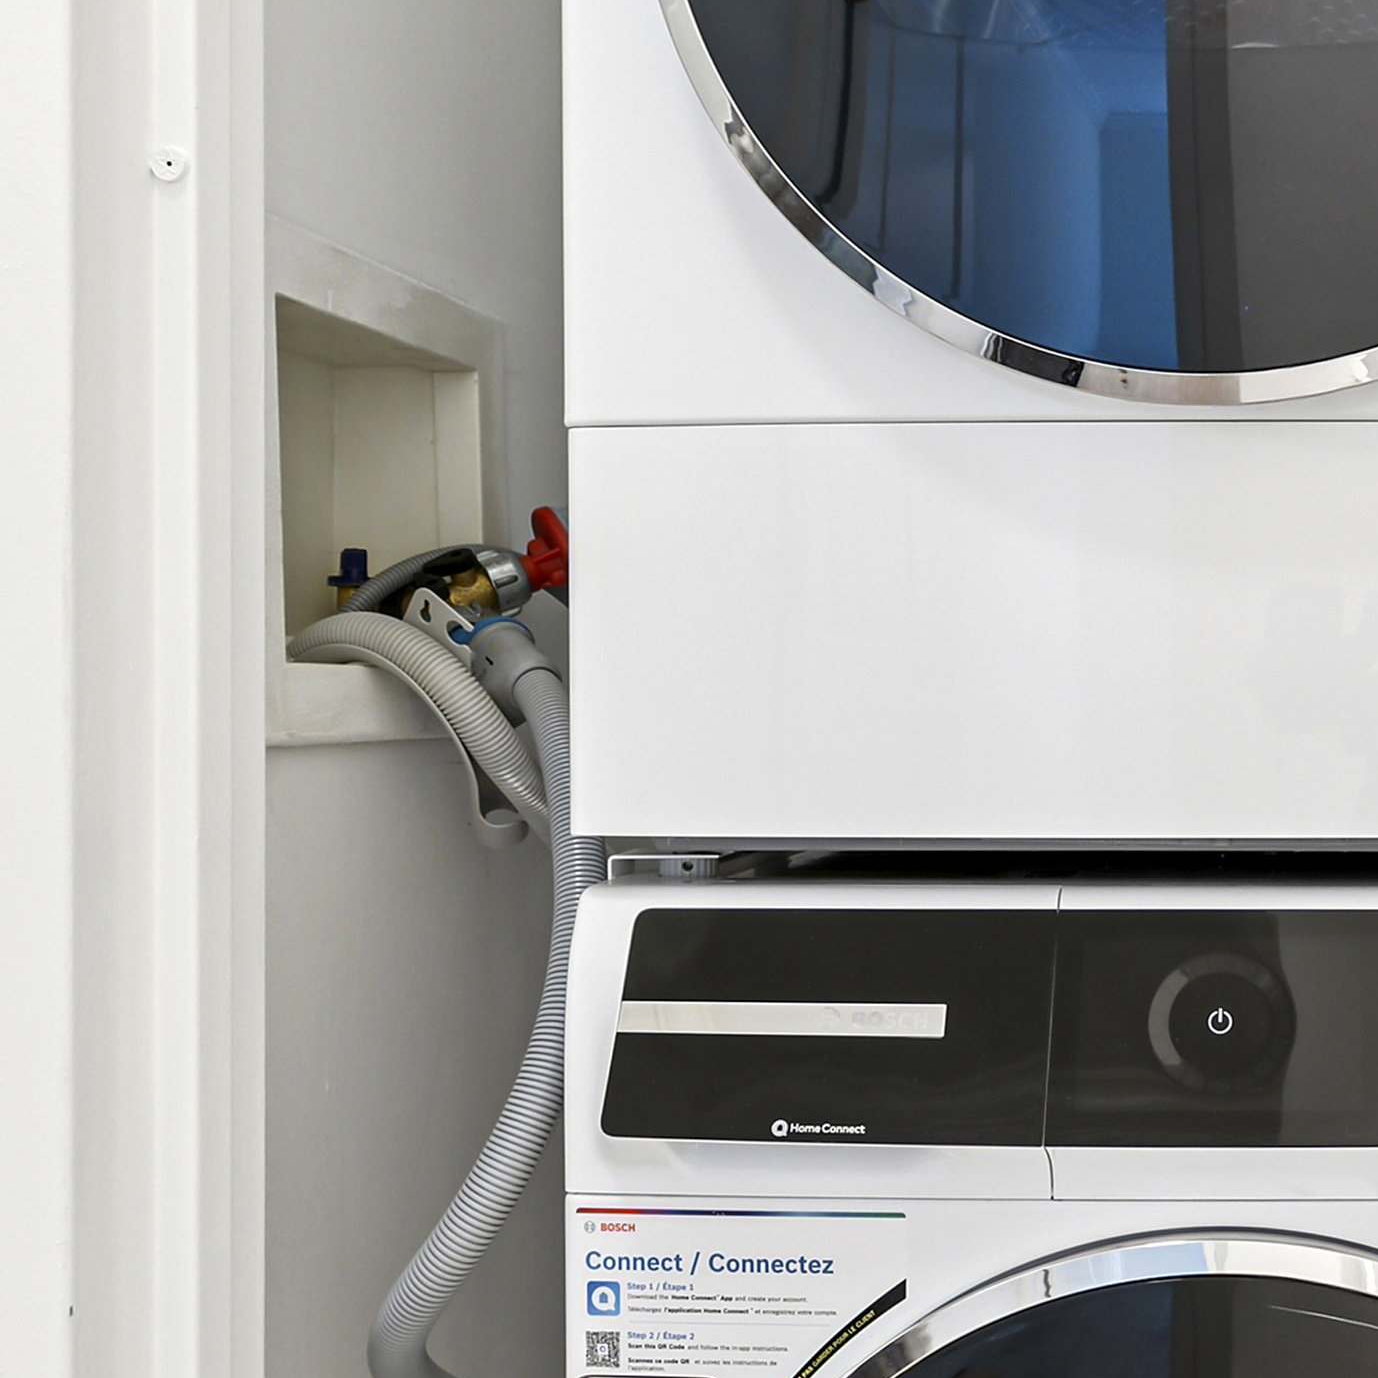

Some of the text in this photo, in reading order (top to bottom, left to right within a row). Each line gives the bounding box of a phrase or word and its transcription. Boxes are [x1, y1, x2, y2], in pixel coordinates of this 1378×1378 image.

[790, 1123, 866, 1134] Home Connect
[600, 1223, 636, 1232] BOSCH
[585, 1252, 833, 1274] Connect / Connectez
[627, 1282, 646, 1291] Step
[655, 1282, 660, 1292] /
[662, 1282, 687, 1291] Étape
[689, 1283, 694, 1291] 1
[627, 1331, 695, 1341] Step 2 / Étape 2
